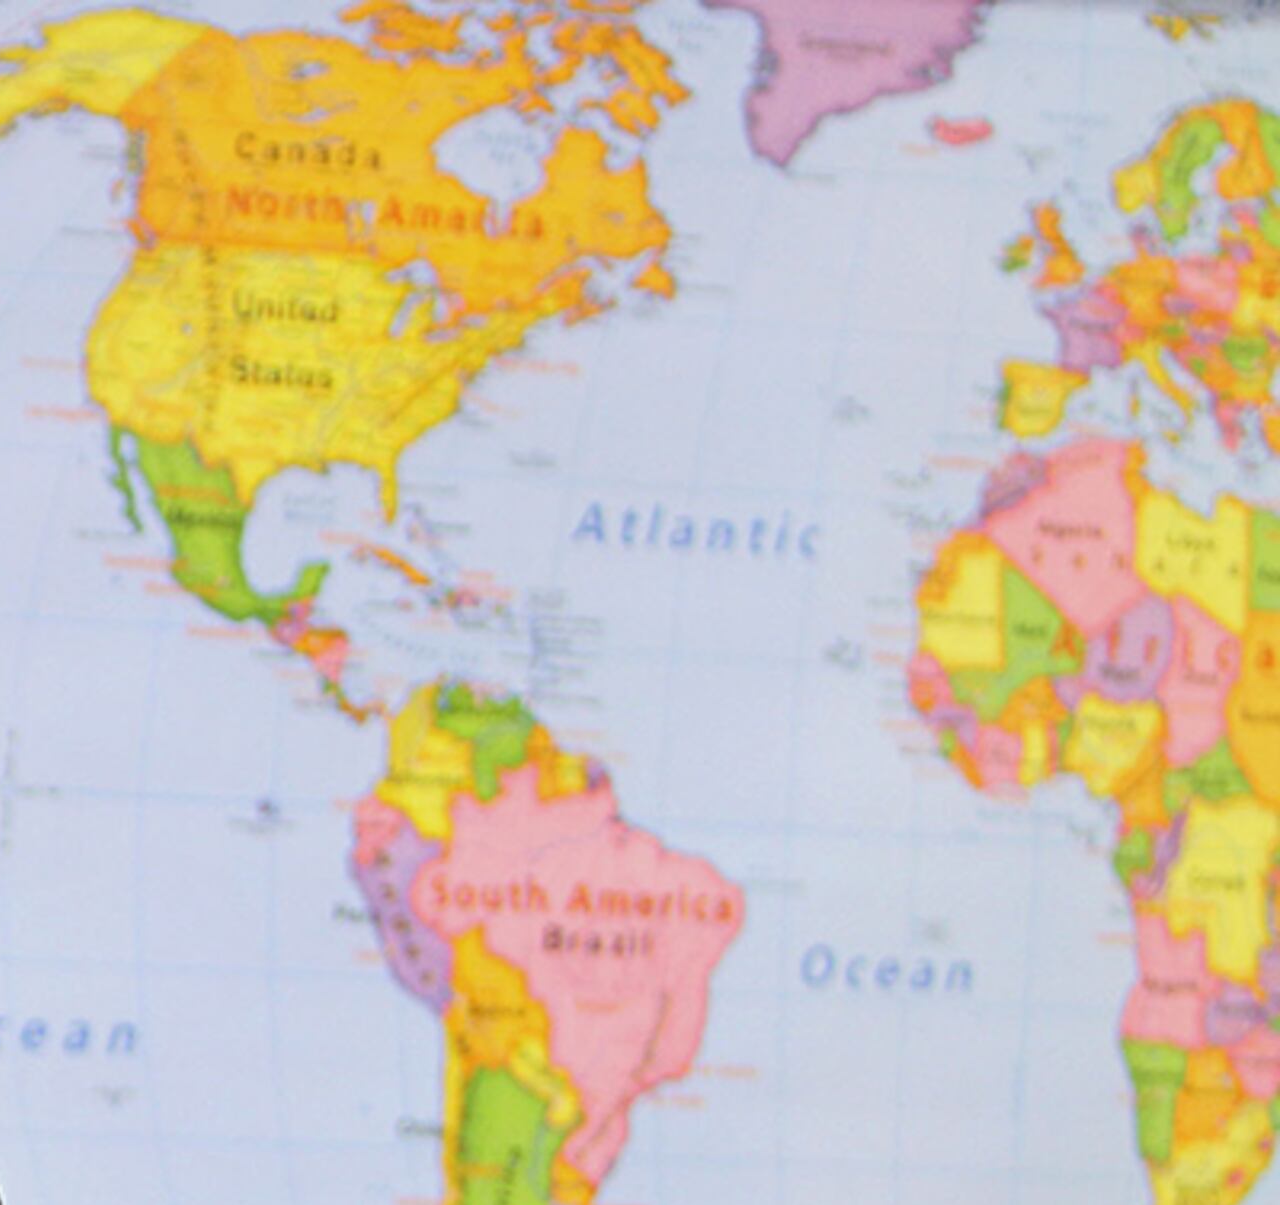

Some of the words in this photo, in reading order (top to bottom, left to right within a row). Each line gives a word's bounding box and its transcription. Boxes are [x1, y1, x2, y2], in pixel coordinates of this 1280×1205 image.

[234, 130, 384, 172] Canada
[226, 186, 346, 224] North
[230, 286, 340, 324] United
[228, 354, 334, 390] States
[568, 500, 822, 558] Atlantic
[430, 872, 550, 914] South
[564, 880, 736, 926] America
[542, 922, 656, 960] Brazil
[798, 942, 977, 995] Ocean
